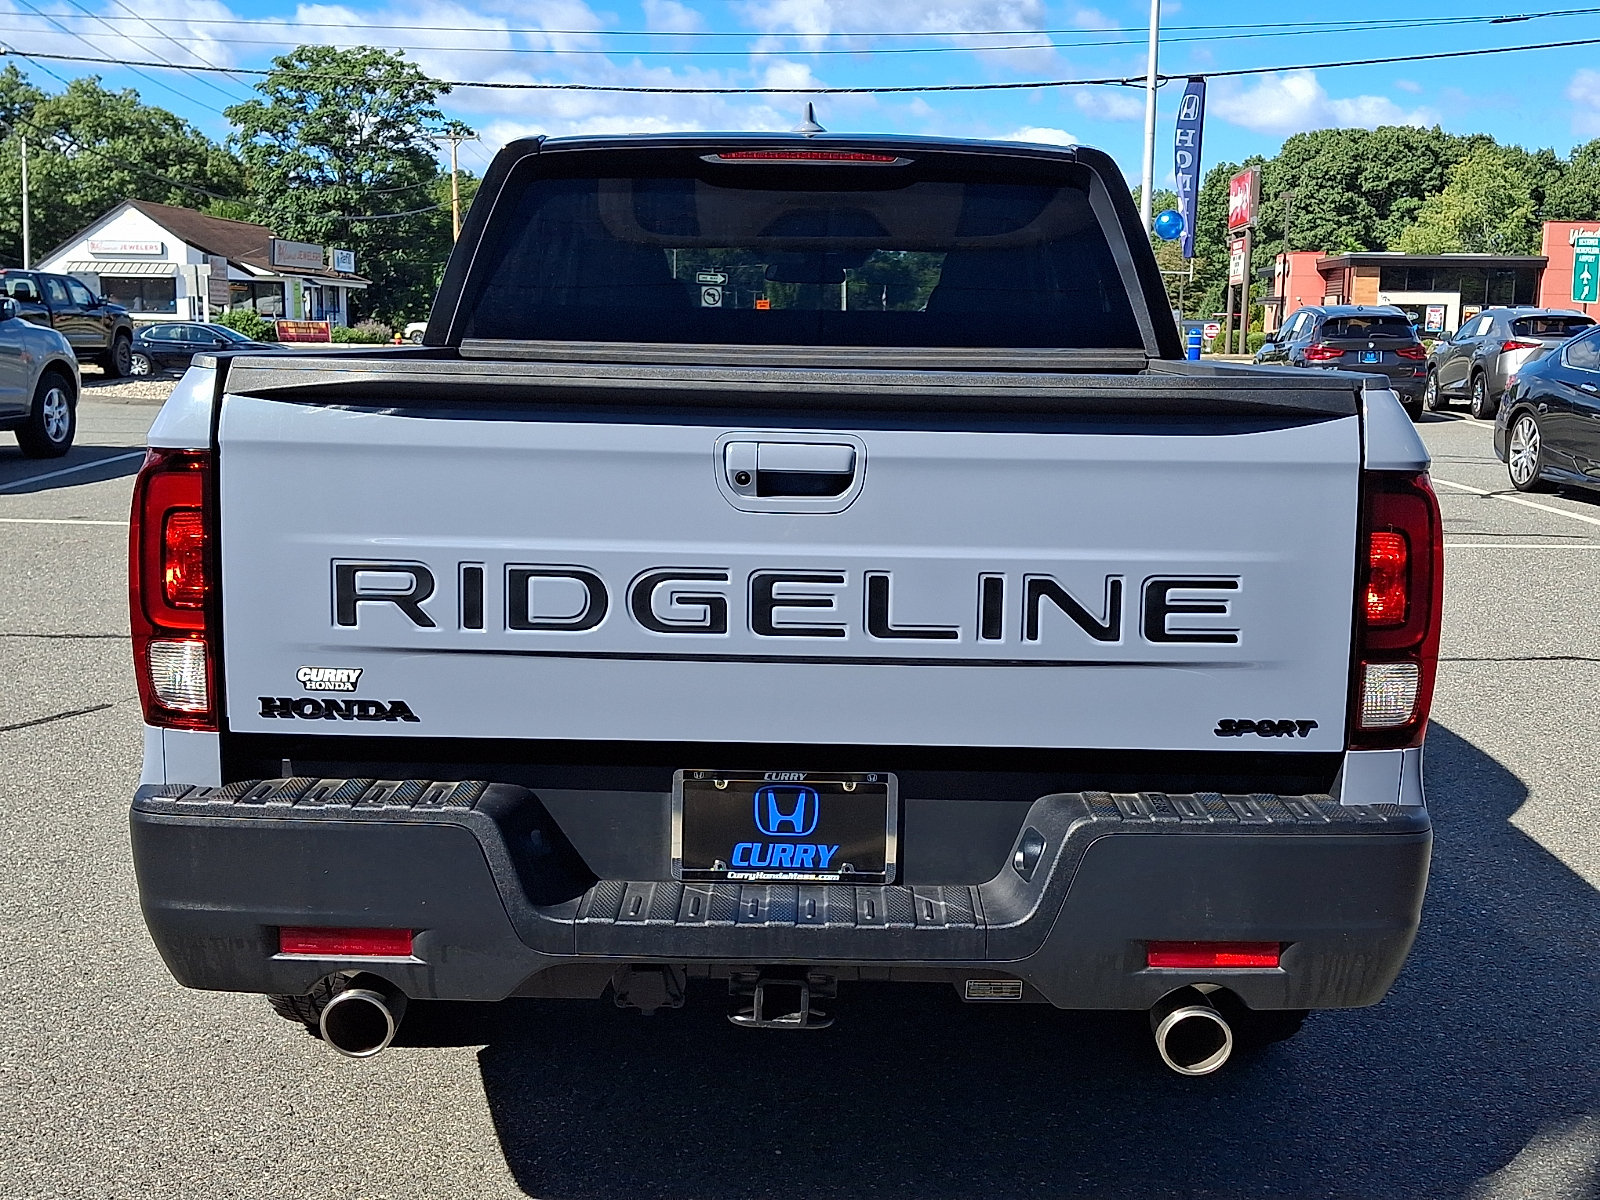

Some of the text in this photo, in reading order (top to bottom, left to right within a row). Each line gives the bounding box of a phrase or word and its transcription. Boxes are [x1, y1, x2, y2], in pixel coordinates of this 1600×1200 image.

[330, 556, 1243, 646] RIDGELINE
[297, 667, 362, 682] CURRY
[305, 681, 354, 691] HONDA
[257, 696, 421, 723] HONDA
[1213, 718, 1319, 738] SPORT
[763, 771, 808, 781] CURRY
[731, 842, 840, 868] CURRY
[726, 871, 840, 881] CurryHondaMass.com
